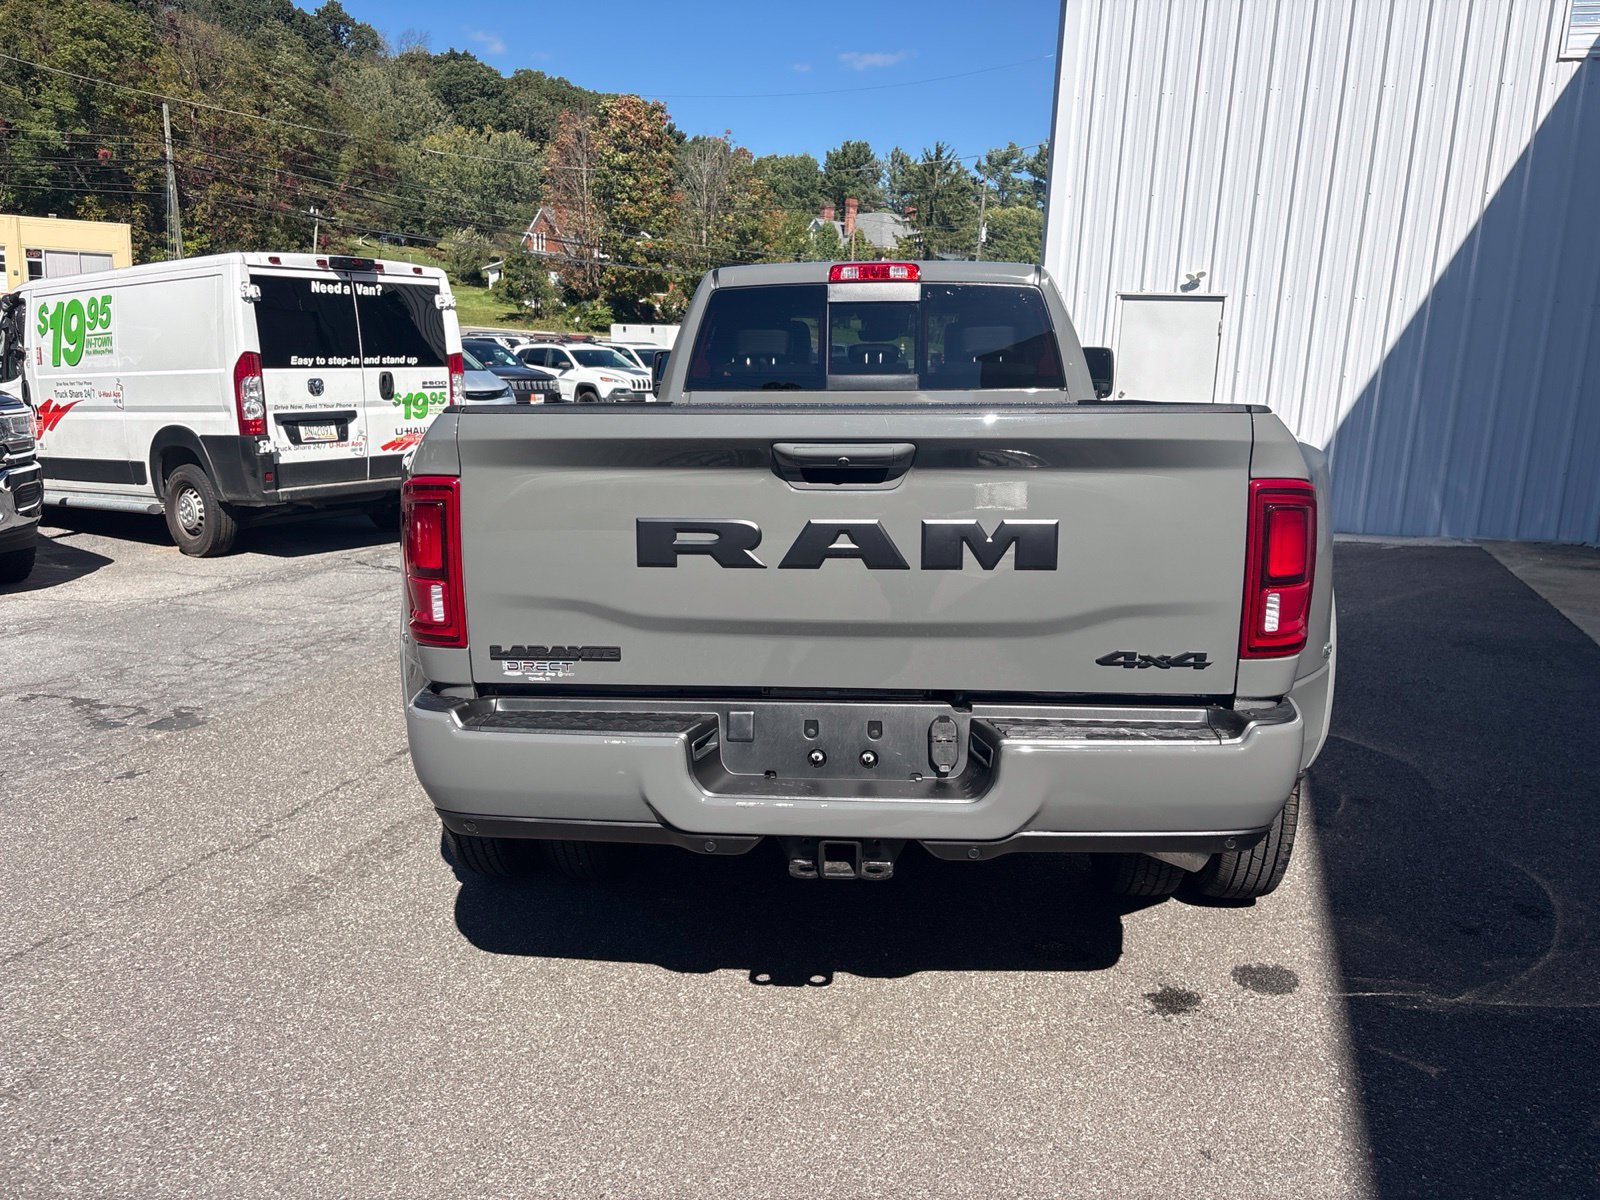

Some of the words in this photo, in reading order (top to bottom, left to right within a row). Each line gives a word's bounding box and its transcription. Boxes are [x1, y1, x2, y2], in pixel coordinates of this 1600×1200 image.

[311, 281, 342, 294] Need
[343, 285, 350, 295] a
[356, 283, 383, 296] Van?
[86, 336, 112, 349] IN-TOWN
[290, 356, 313, 366] Easy
[316, 356, 325, 365] to
[328, 356, 360, 366] step-in
[364, 356, 379, 365] and
[382, 355, 405, 365] stand
[407, 356, 418, 366] up
[54, 389, 68, 399] Truck
[68, 389, 83, 399] Share
[84, 388, 96, 400] 24/7
[395, 426, 429, 436] U-HAU
[313, 442, 326, 450] 24/7
[328, 441, 349, 449] U-Haul
[636, 517, 1059, 571] RAM
[490, 645, 622, 662] LARAMIE
[506, 661, 574, 672] DIRECT
